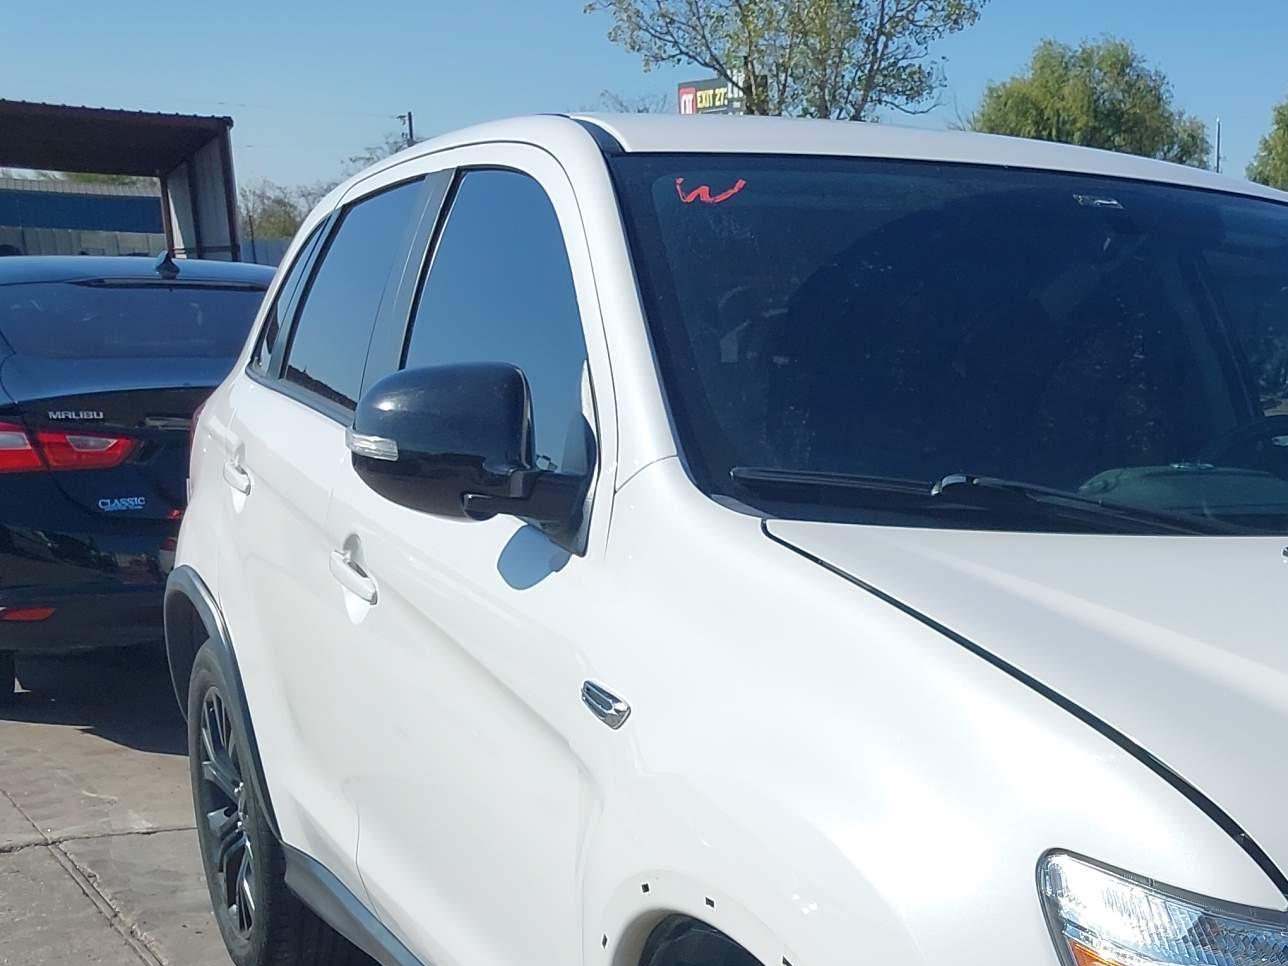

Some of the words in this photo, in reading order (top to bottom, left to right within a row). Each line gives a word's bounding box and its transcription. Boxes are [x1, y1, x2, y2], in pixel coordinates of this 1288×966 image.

[697, 89, 714, 109] EXIT
[48, 411, 103, 420] MALIBU
[98, 497, 146, 509] CLASSIC
